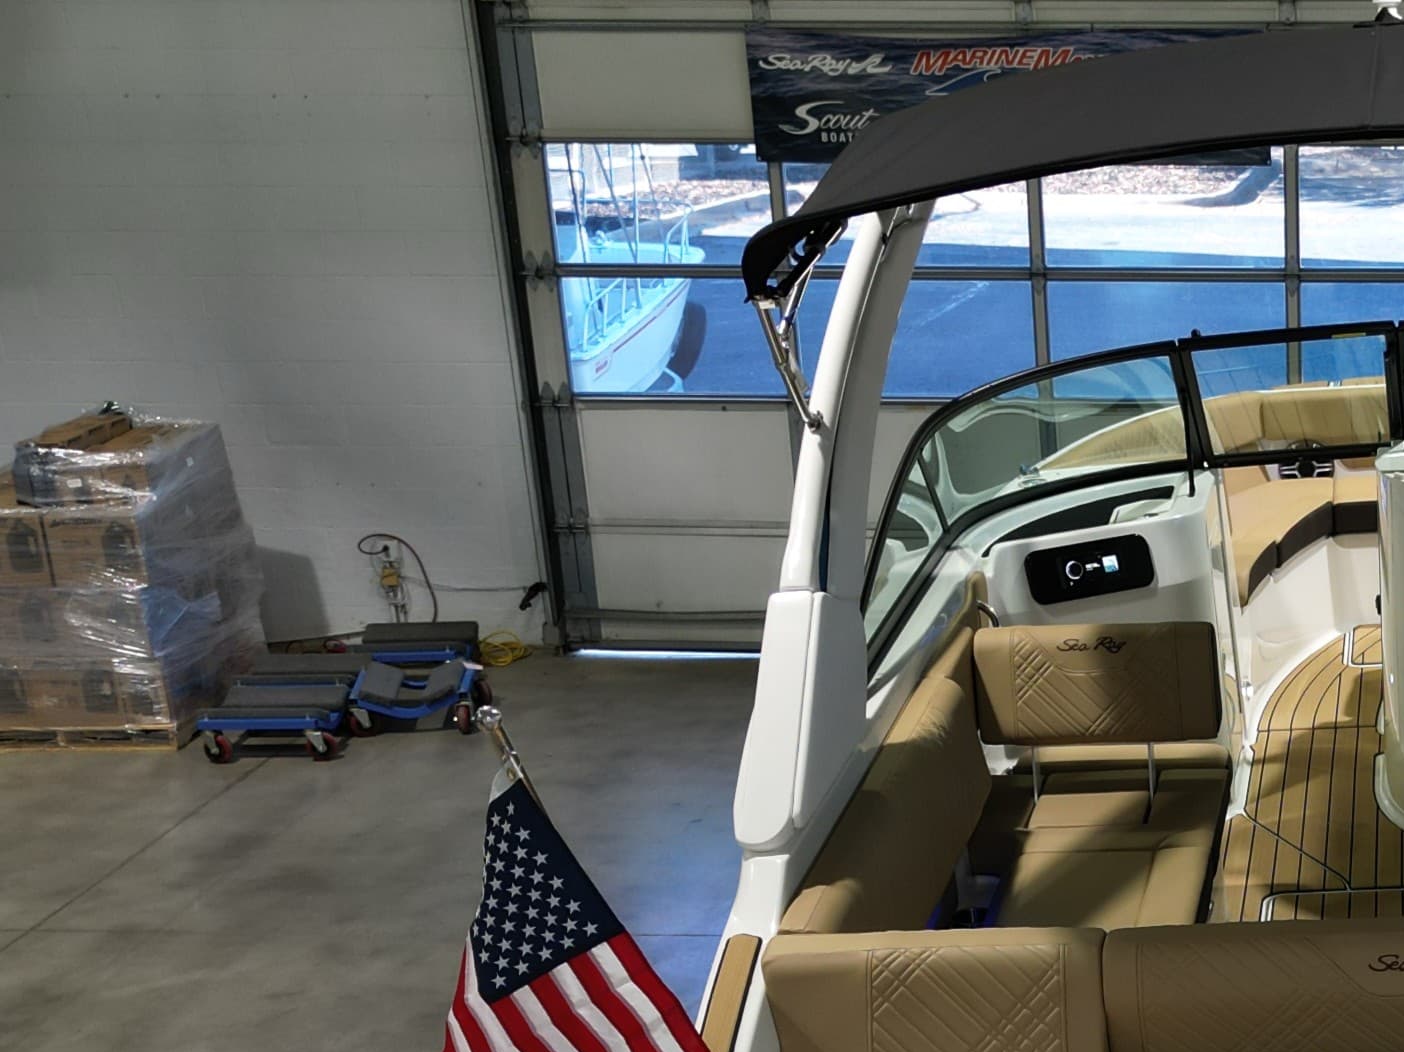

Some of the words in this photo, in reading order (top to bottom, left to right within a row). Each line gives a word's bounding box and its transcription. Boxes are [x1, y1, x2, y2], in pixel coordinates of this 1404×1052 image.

[778, 101, 880, 135] Scout
[821, 132, 857, 143] BOAT
[1056, 638, 1090, 651] Sea
[1093, 636, 1127, 654] Ray
